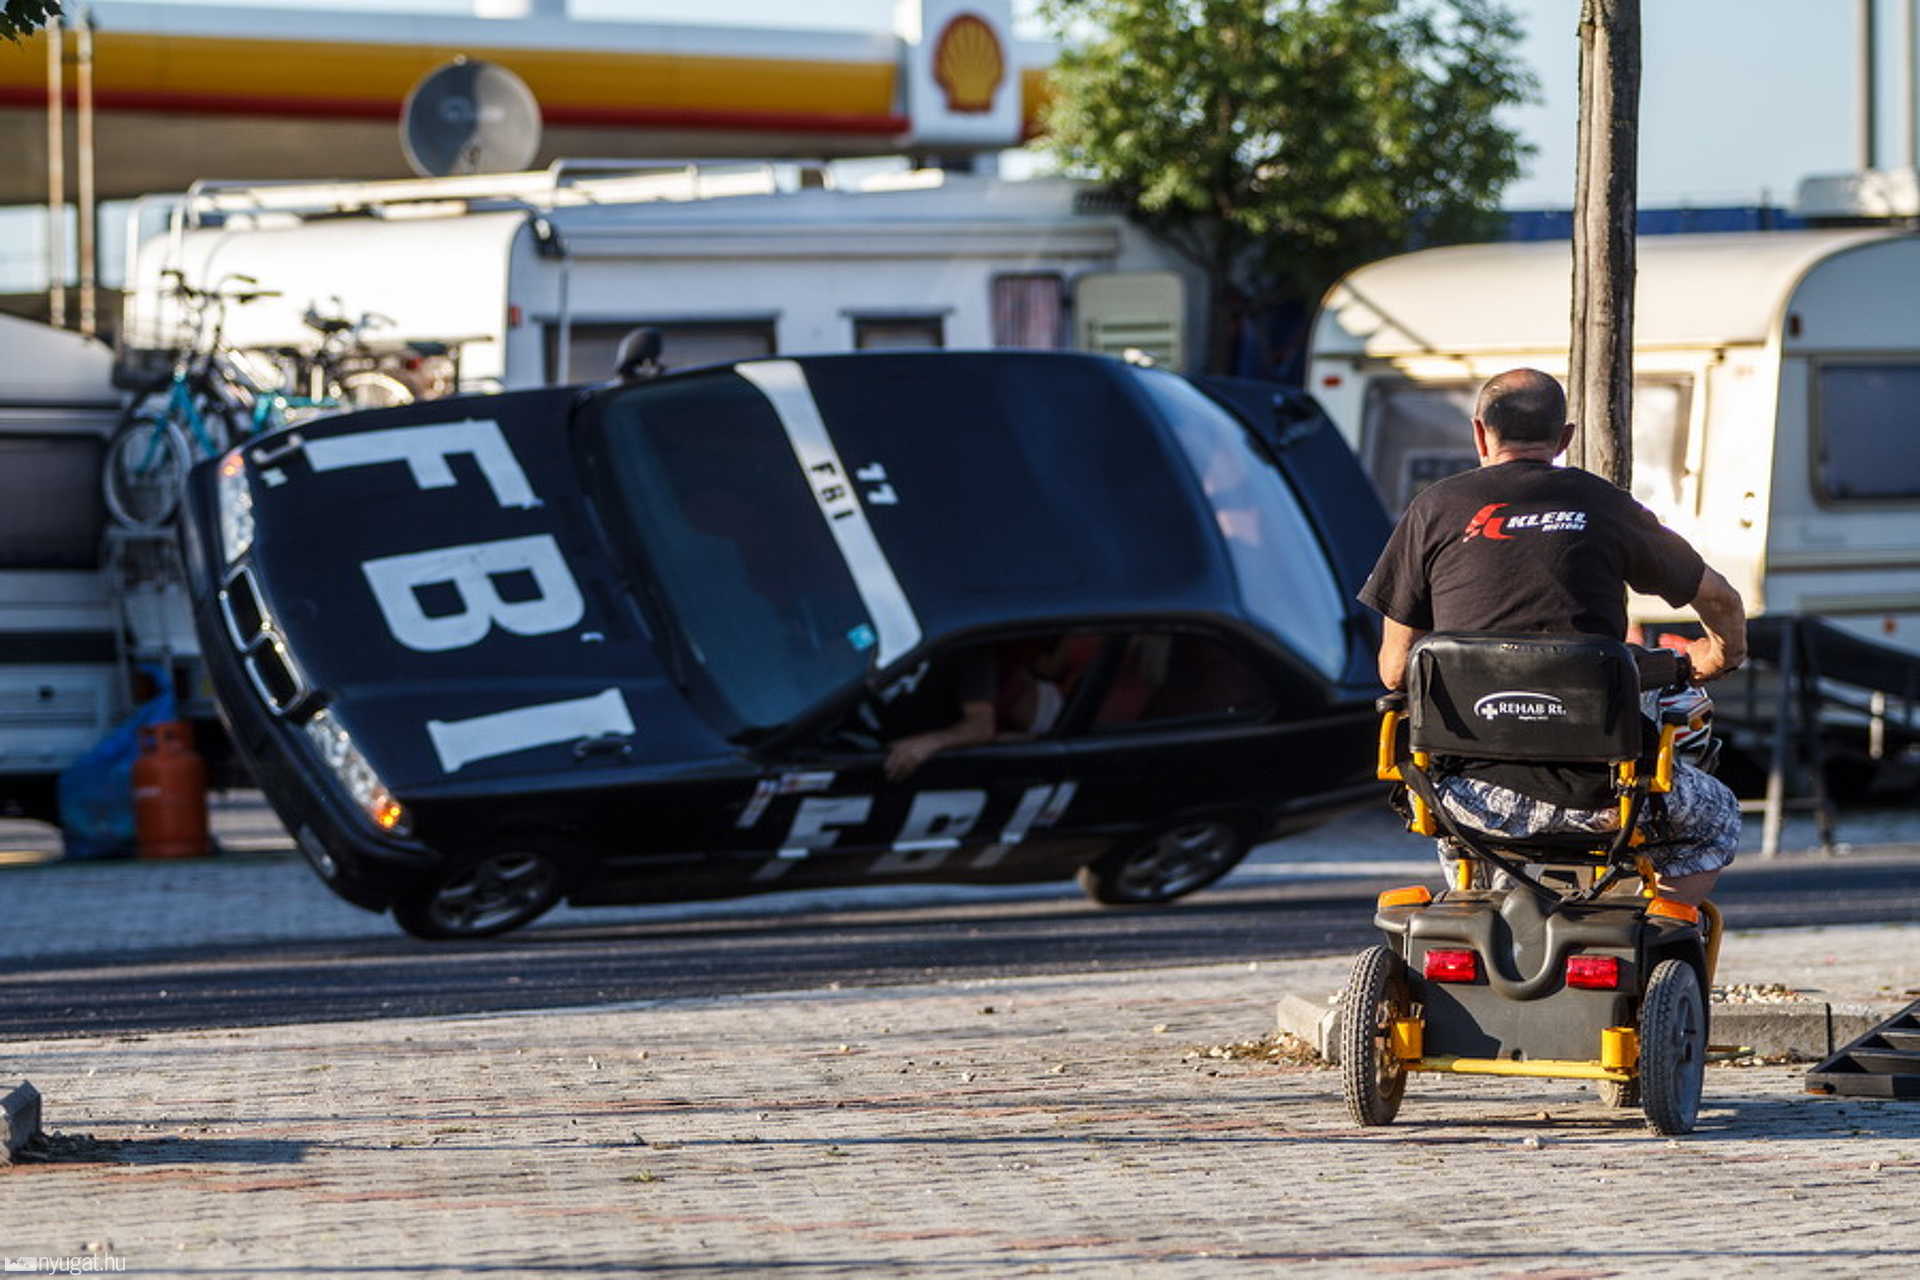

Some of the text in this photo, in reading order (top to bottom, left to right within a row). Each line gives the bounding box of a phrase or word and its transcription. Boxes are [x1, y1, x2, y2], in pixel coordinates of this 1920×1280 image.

[811, 461, 855, 520] FBI
[1506, 511, 1588, 529] KLEKL
[303, 418, 636, 774] FBI
[1499, 702, 1567, 715] REHAB Rt.
[752, 789, 1055, 881] FBI
